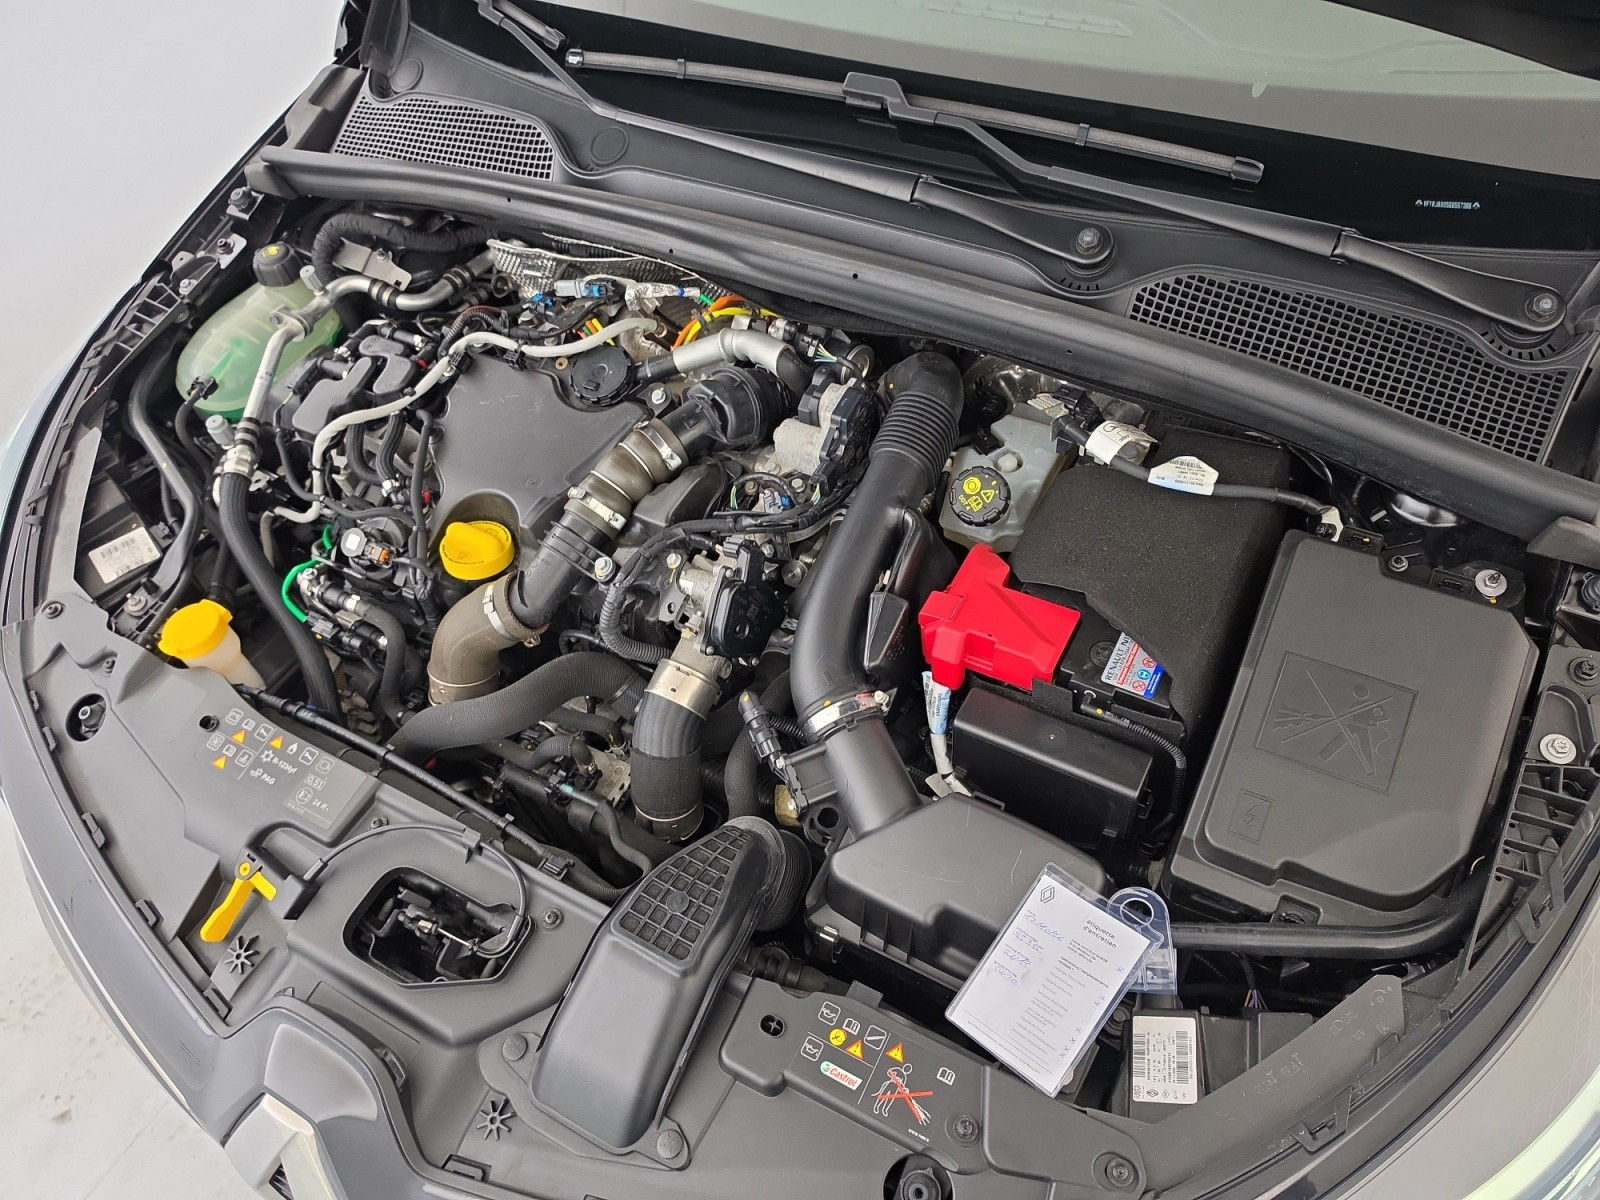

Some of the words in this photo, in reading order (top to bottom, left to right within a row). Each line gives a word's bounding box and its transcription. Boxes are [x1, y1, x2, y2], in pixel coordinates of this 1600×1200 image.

[959, 495, 968, 505] DOT
[1104, 648, 1125, 681] RENAULT
[261, 774, 275, 785] PAG
[1082, 926, 1117, 949] d'entretien
[1086, 920, 1115, 939] étiquette
[829, 1067, 858, 1088] Castrol
